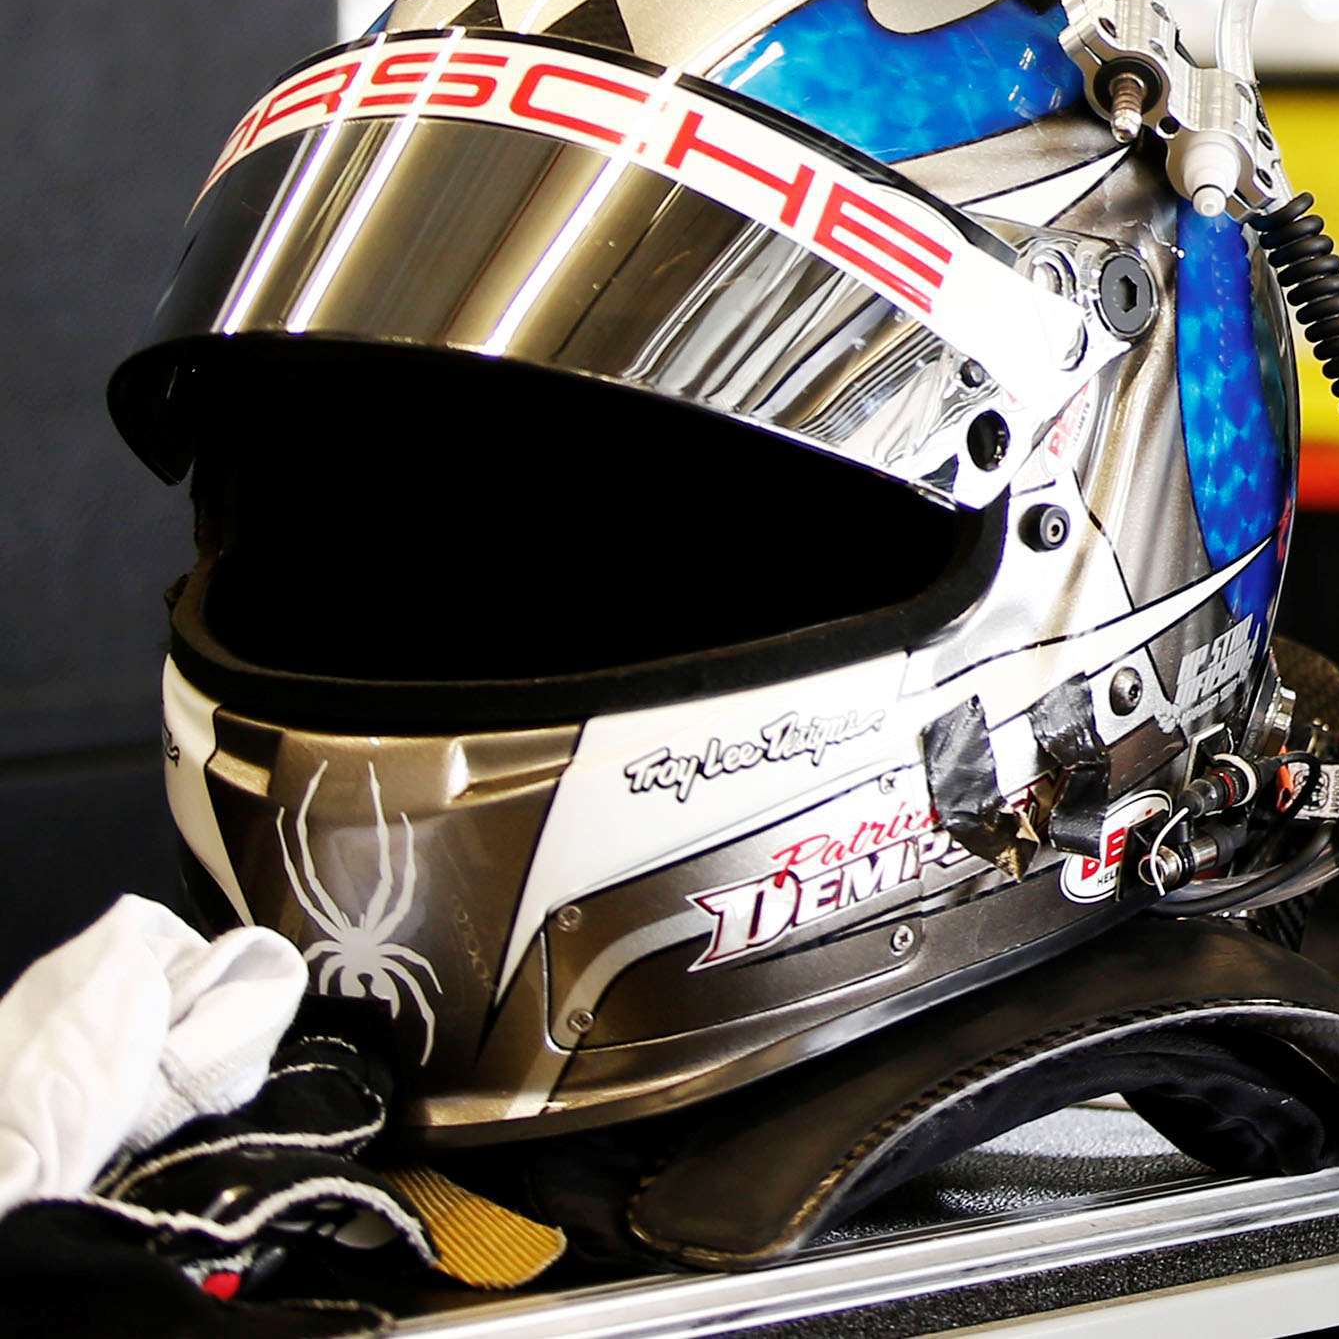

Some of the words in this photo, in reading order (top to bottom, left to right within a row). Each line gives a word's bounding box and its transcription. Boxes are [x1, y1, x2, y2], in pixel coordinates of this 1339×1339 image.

[203, 52, 953, 314] ORSCHE
[624, 746, 699, 803] Troy
[698, 737, 764, 779] Lee
[772, 800, 942, 888] Patric
